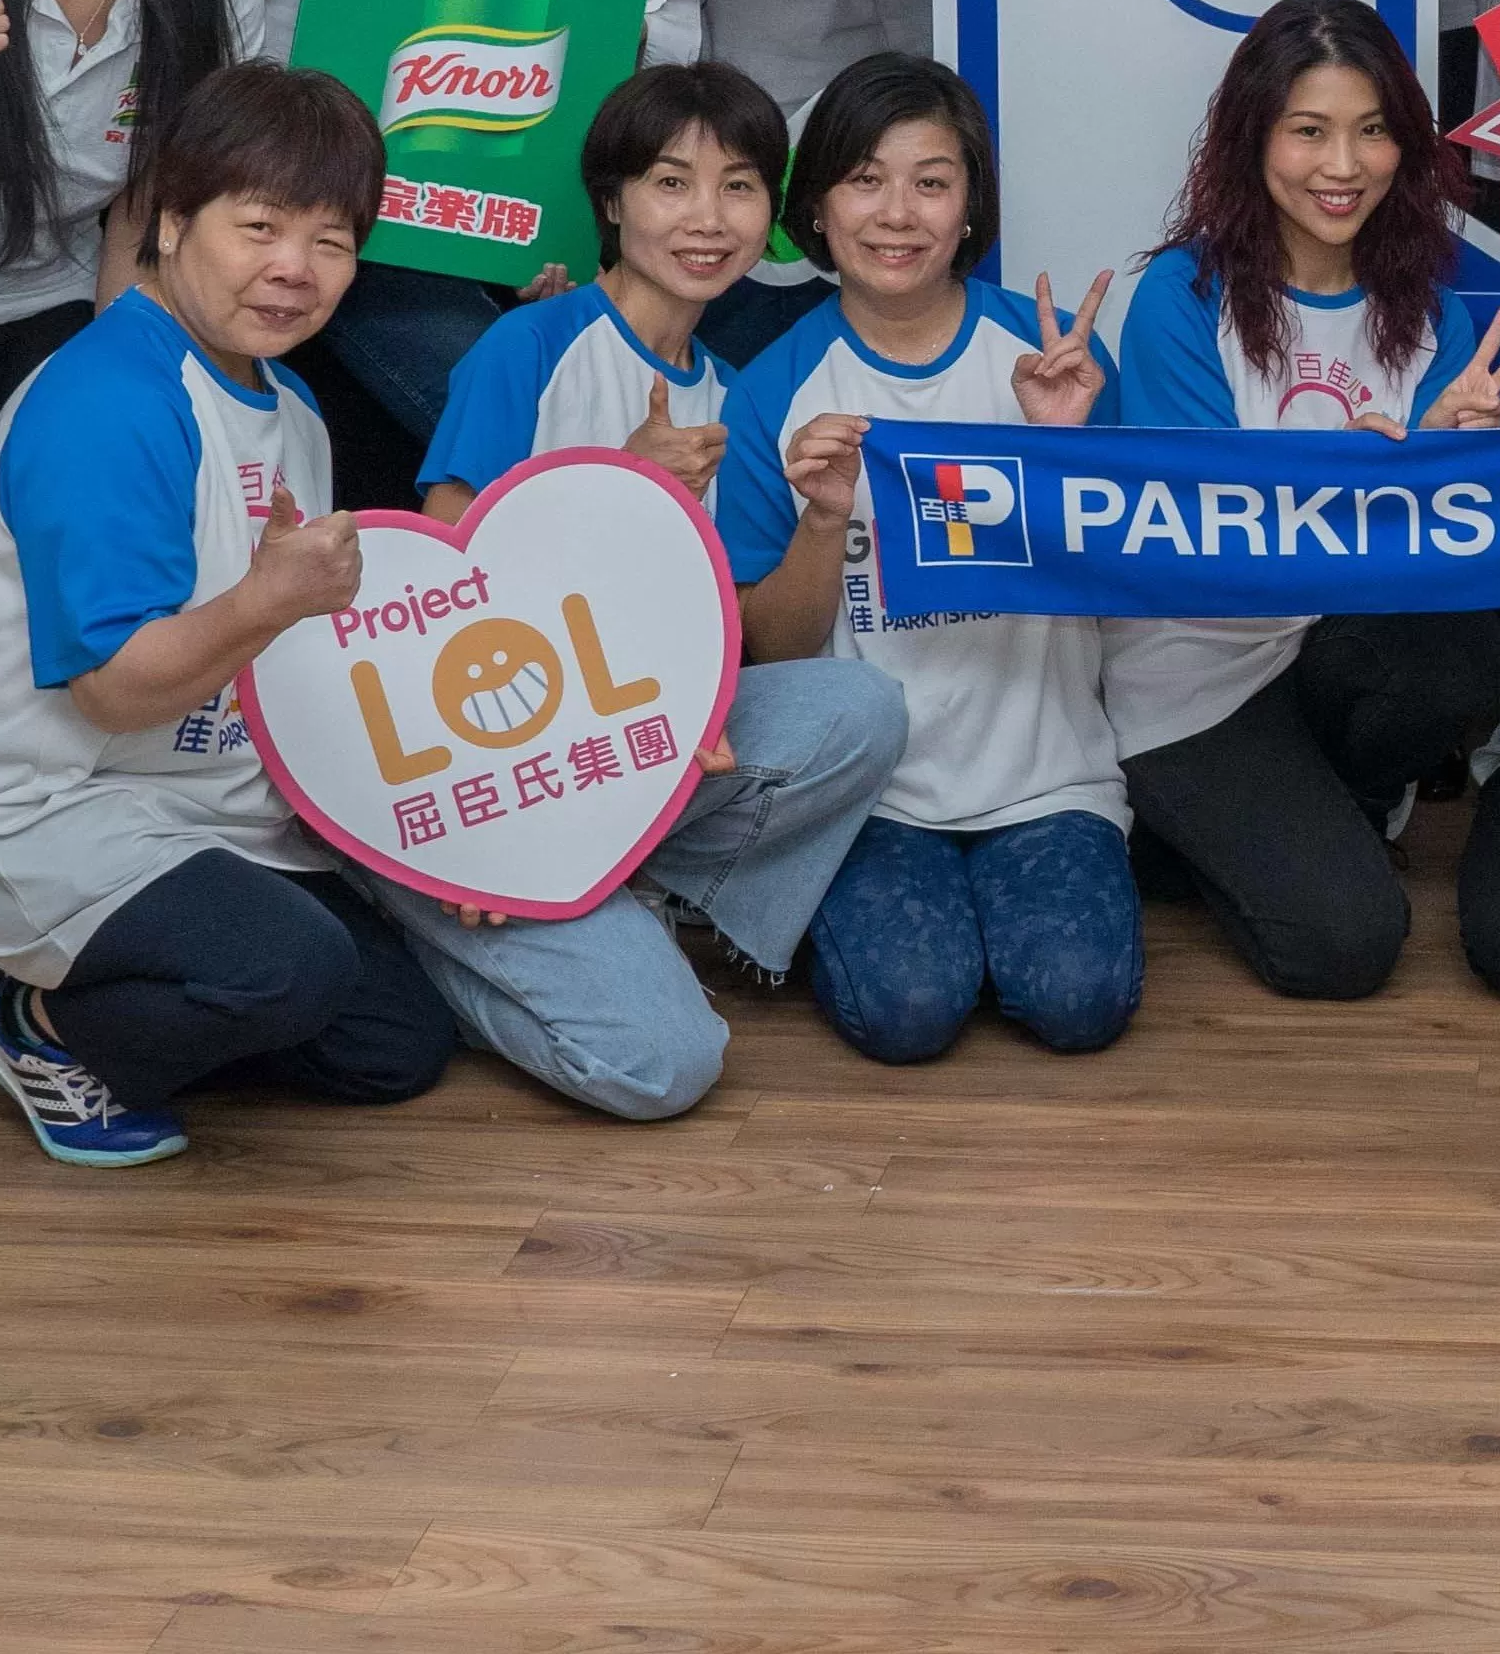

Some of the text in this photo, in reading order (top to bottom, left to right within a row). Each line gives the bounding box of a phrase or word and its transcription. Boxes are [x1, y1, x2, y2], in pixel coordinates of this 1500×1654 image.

[393, 53, 554, 105] Knorr
[331, 564, 491, 648] Project
[844, 573, 875, 634] 百佳
[392, 713, 679, 850] 屈臣氏集團
